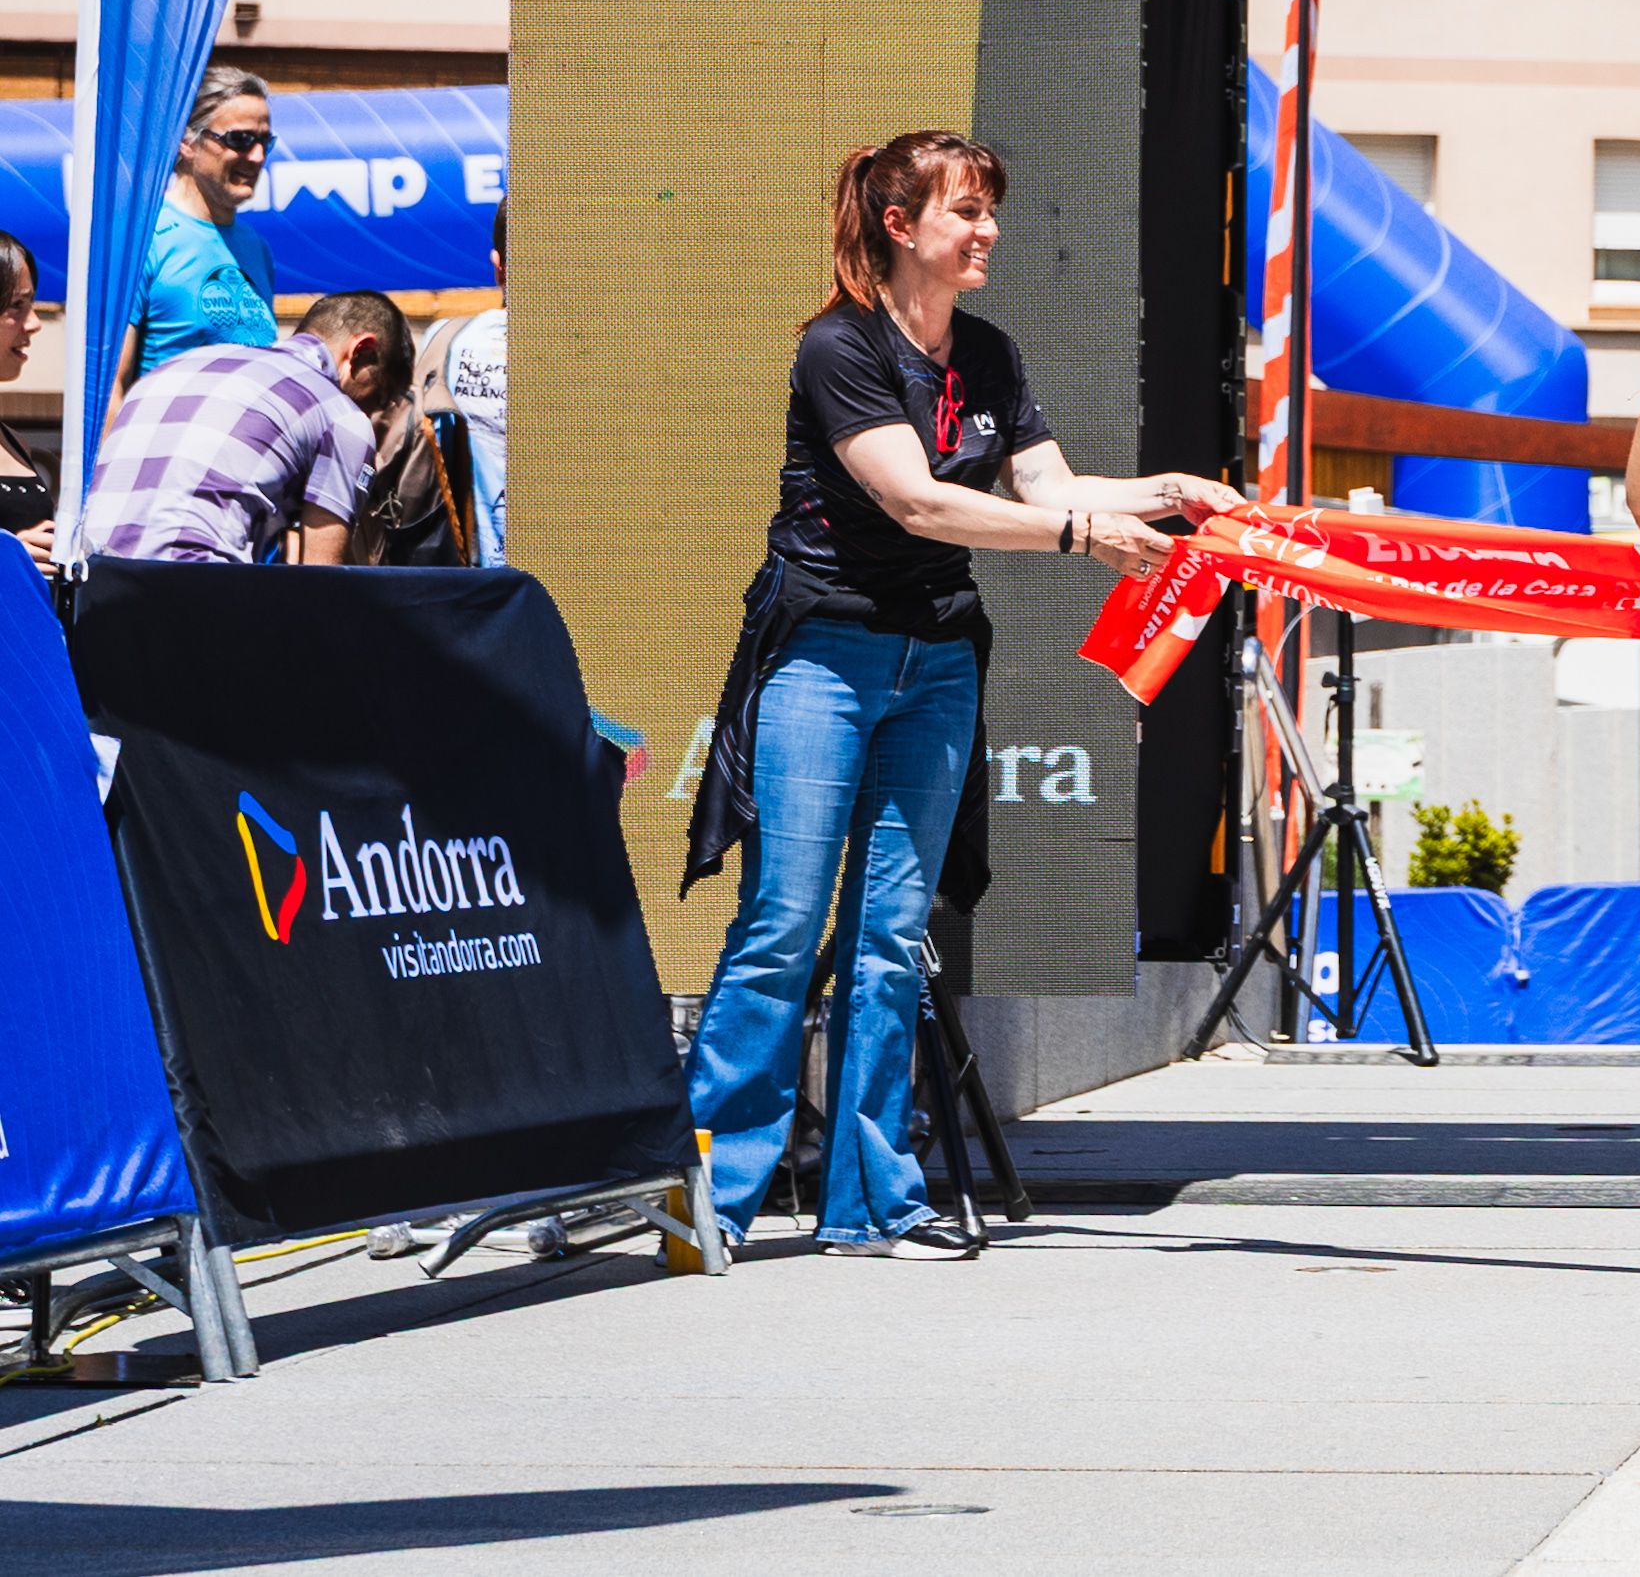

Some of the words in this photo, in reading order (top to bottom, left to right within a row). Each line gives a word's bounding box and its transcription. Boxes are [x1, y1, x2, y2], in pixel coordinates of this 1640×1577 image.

[1523, 578, 1597, 598] Casa
[319, 804, 526, 922] Andorra
[382, 927, 542, 980] visitandorra.com
